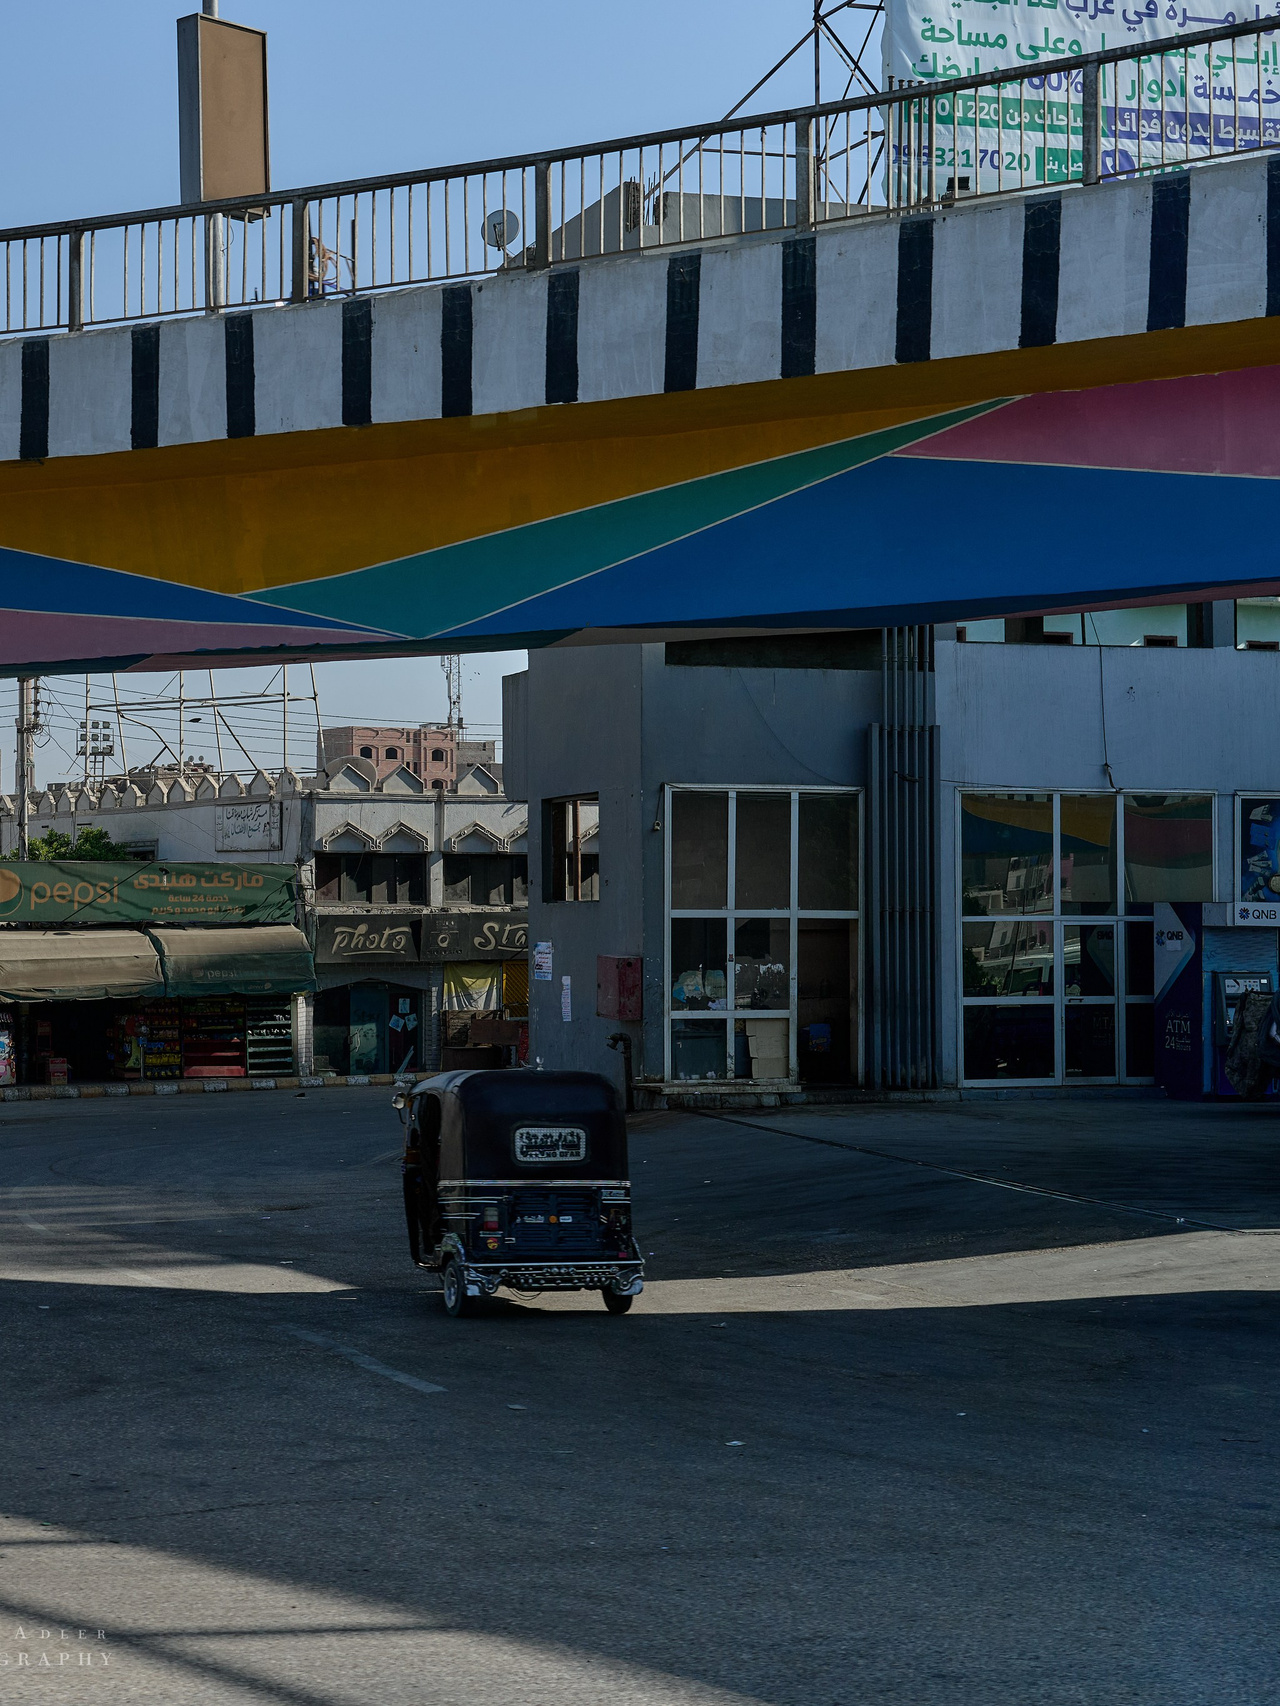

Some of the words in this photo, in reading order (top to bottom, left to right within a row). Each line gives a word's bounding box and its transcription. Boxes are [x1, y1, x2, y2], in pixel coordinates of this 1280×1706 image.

[920, 17, 1008, 50] مساحة
[1125, 66, 1186, 103] أدوار
[1193, 75, 1280, 104] خمسة
[966, 101, 1001, 120] 220
[1005, 108, 1031, 126] من
[1165, 120, 1211, 144] بدون
[200, 871, 264, 891] ماركت
[29, 876, 119, 911] pepsi
[168, 894, 191, 903] ساعة
[192, 894, 205, 902] 24
[206, 894, 229, 903] خدمة
[1252, 909, 1277, 921] QNB
[331, 922, 412, 955] photo
[1166, 930, 1184, 941] QNB
[206, 967, 237, 980] pepsi
[1165, 1019, 1191, 1034] ATM
[1164, 1035, 1176, 1049] 24
